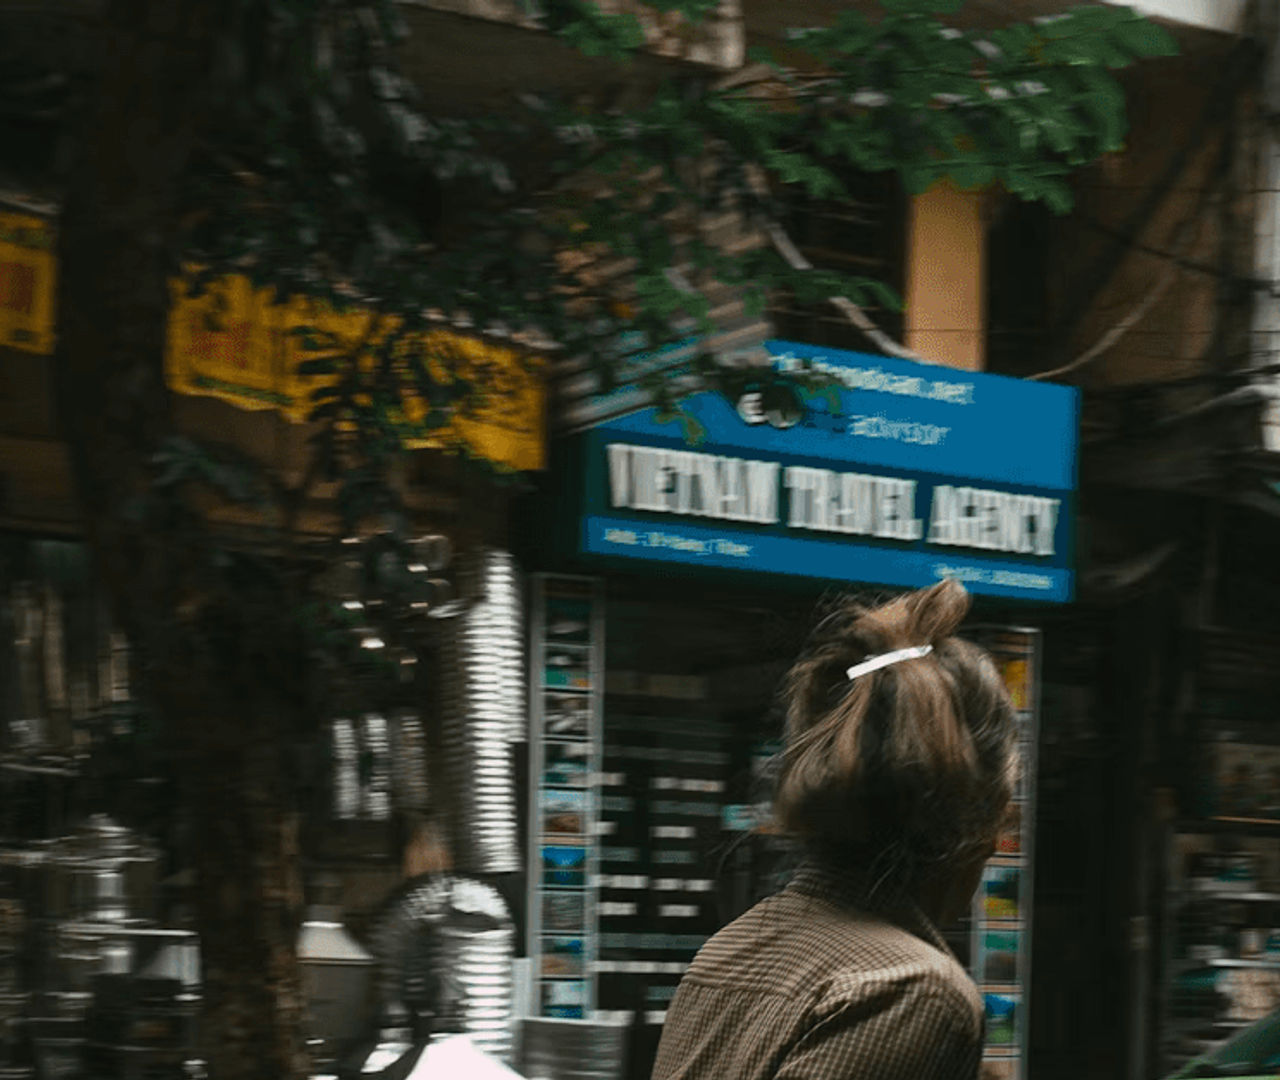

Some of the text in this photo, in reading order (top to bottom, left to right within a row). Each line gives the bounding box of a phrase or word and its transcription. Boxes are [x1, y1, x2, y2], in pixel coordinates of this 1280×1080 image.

[605, 442, 1061, 556] VIETNAM TRAVEL AGENCY
